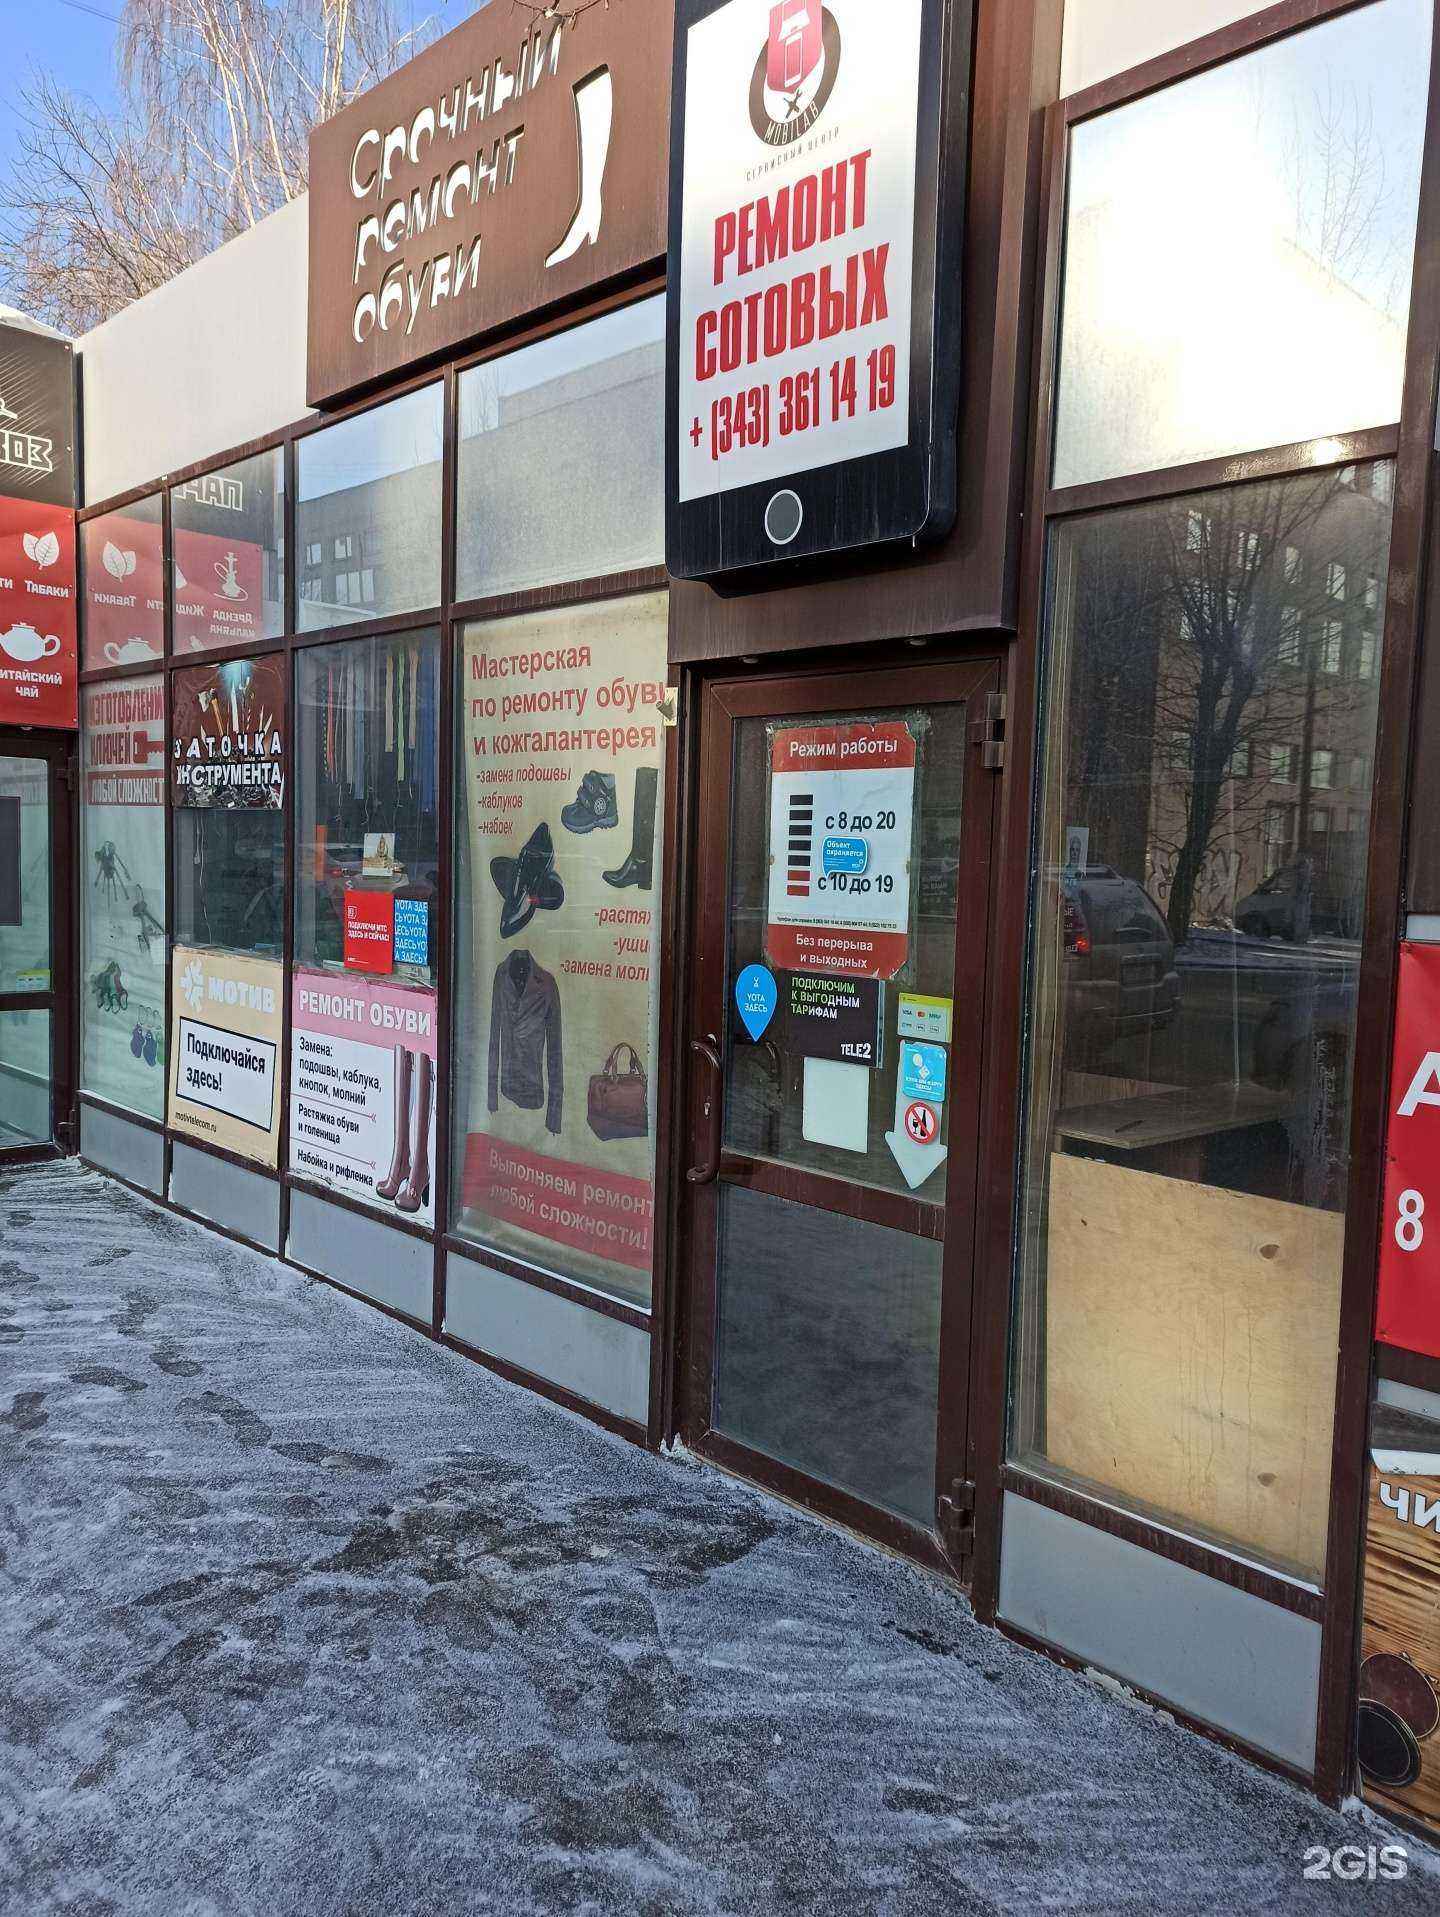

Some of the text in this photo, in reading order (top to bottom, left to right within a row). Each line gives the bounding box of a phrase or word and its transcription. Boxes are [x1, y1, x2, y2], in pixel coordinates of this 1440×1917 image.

[764, 100, 819, 145] MOBILAB
[713, 149, 872, 286] РЕМОНТ
[695, 243, 890, 381] СОТОВЫХ
[690, 344, 897, 461] + (343) 361 14 19
[0, 428, 52, 472] ОЗ
[472, 646, 591, 680] Мастерская
[16, 685, 39, 697] ЧАЙ
[472, 696, 496, 718] по
[502, 687, 589, 721] ремонту
[174, 731, 282, 759] ЗАТОЧКА
[474, 726, 657, 755] и кожгалантерея
[790, 737, 898, 758] Режим работы
[476, 763, 571, 783] -замена подошвы
[477, 791, 523, 813] -каблуков
[478, 817, 513, 835] -набоек
[825, 811, 896, 833] с 8 до 20
[818, 873, 893, 895] с 10 до 19
[594, 907, 651, 926] -растя
[395, 924, 409, 936] ЕСЬ
[796, 934, 873, 952] Без перерыва
[560, 960, 612, 977] -замена
[800, 952, 868, 968] и выходных
[792, 977, 855, 993] ПОДКЛЮЧИМ
[745, 1003, 767, 1012] ЗДЕСЬ
[747, 994, 765, 1002] YOTA
[791, 990, 860, 1008] К ВЫГОДНЫМ
[299, 989, 431, 1036] РЕМОНТ ОБУВИ
[791, 1003, 838, 1019] ТАРИФАМ
[187, 1032, 265, 1074] Подключайся
[300, 1036, 333, 1057] Замена:
[841, 1043, 871, 1059] TELE2
[186, 1067, 222, 1092] здесь!
[300, 1059, 382, 1093] подошвы, каблука,
[299, 1077, 366, 1106] кнопок, молний
[298, 1103, 360, 1133] Растяжка обуви
[298, 1123, 340, 1144] и голенища
[297, 1149, 373, 1187] Набойка и рифленка
[489, 1148, 576, 1197] Выполняем
[540, 1203, 648, 1250] сложности!
[1395, 1189, 1425, 1252] 8
